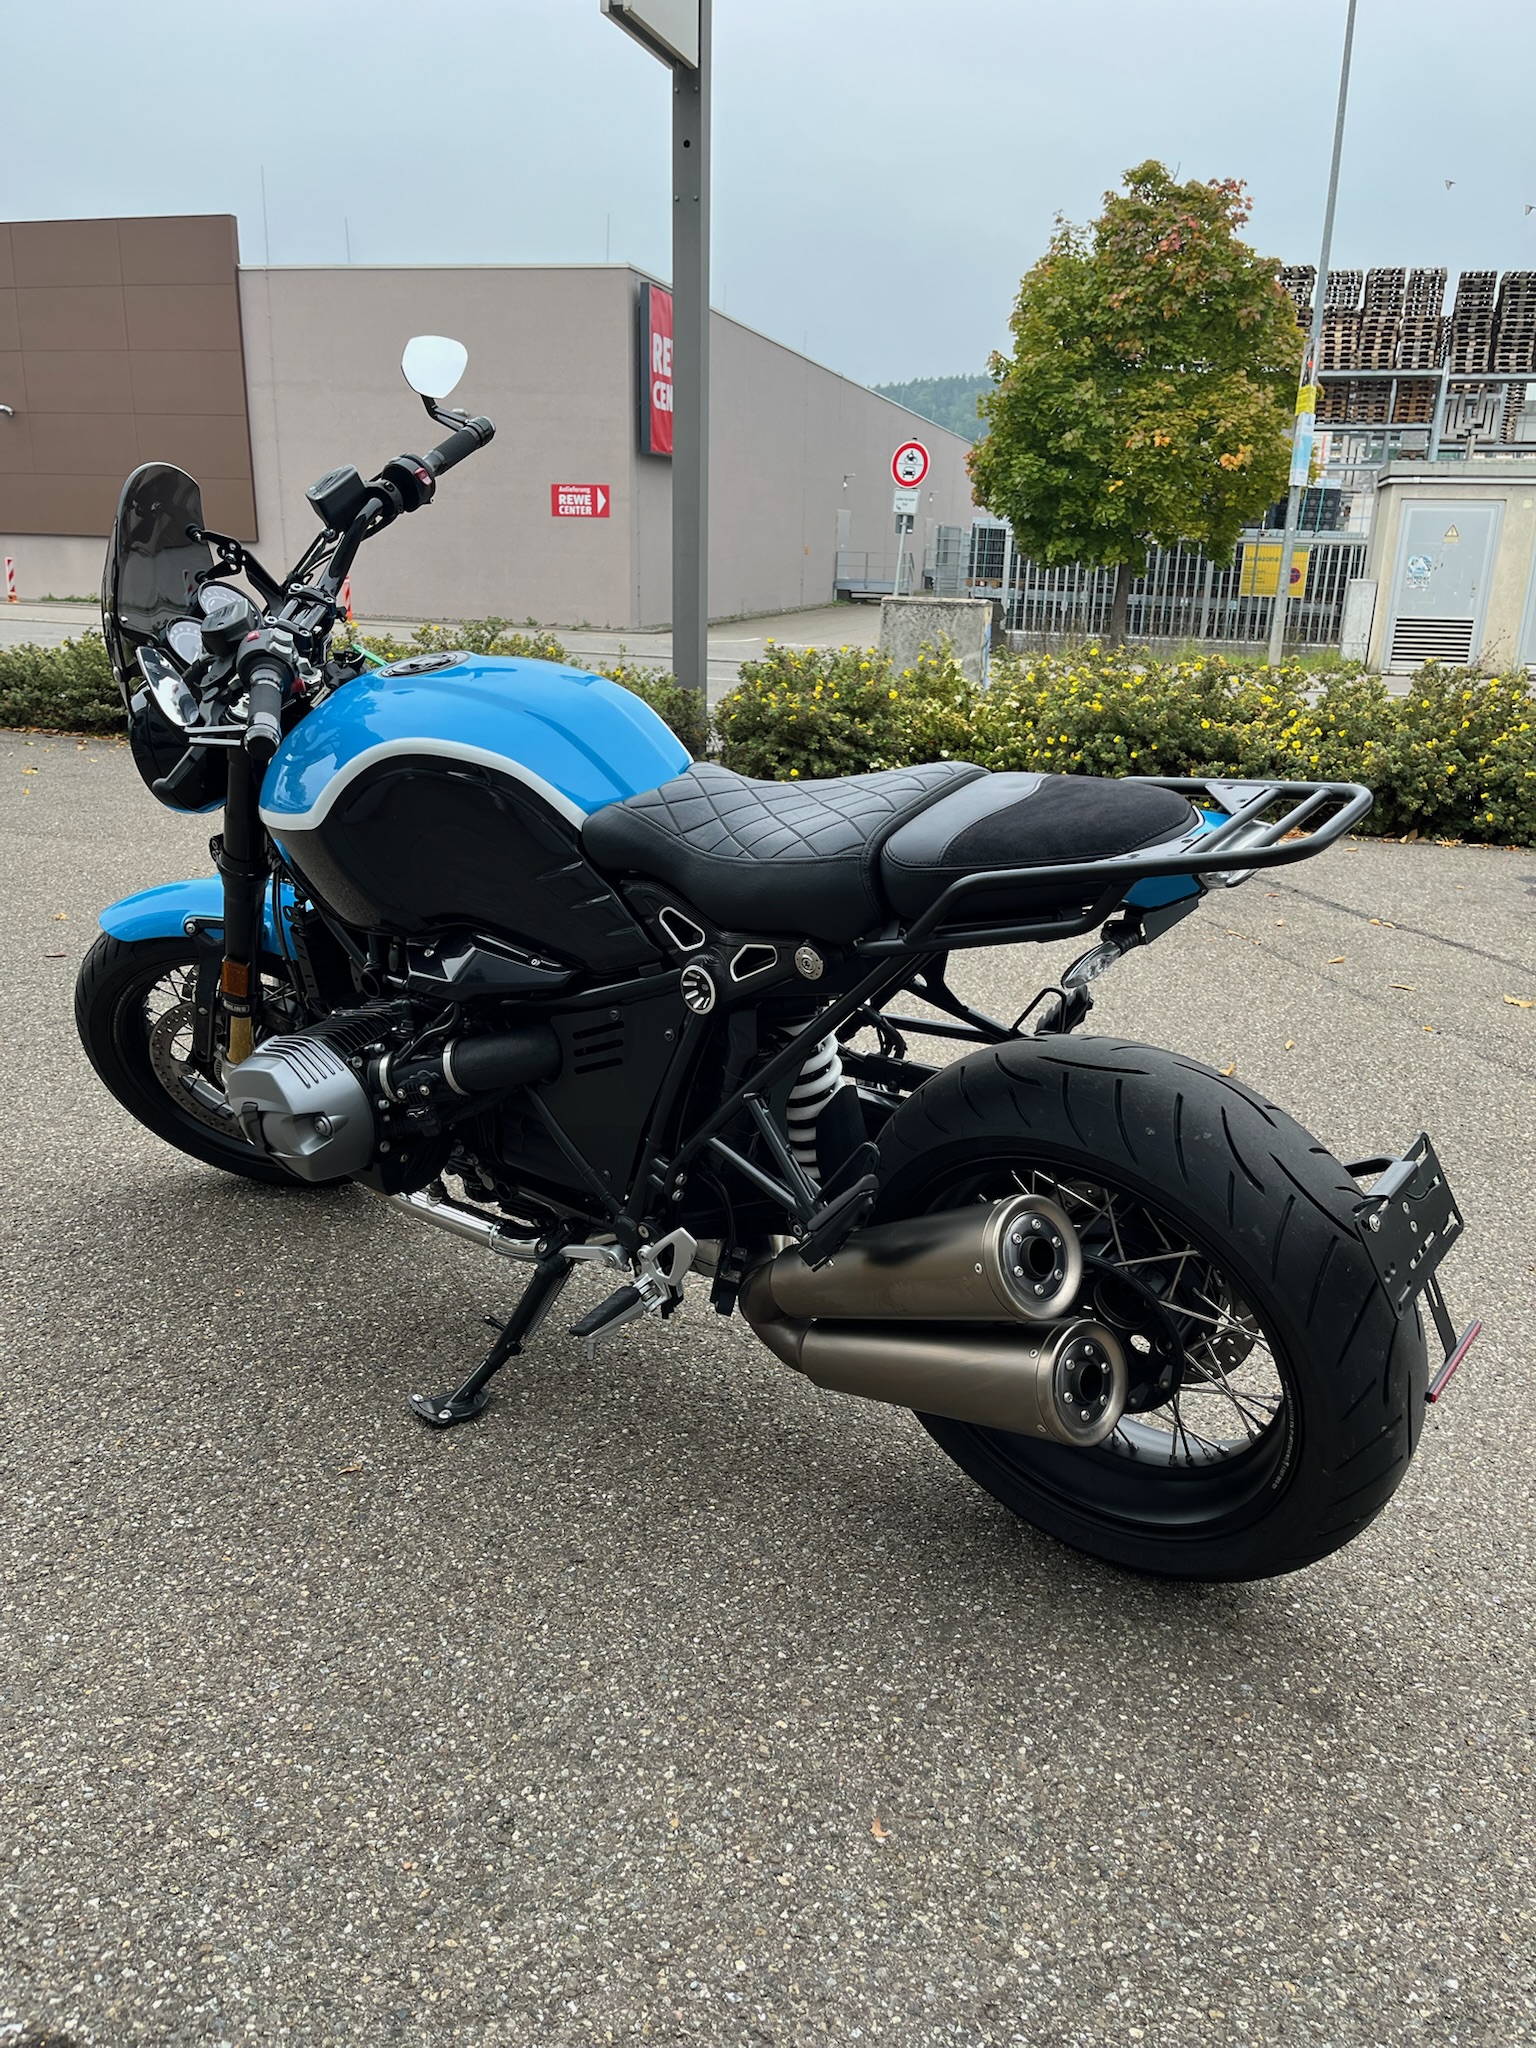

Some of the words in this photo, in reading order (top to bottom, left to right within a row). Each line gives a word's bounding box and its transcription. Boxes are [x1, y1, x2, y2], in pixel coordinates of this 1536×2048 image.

[653, 332, 673, 377] RE
[558, 486, 591, 494] Anlieferung
[558, 494, 592, 505] REWE
[558, 505, 592, 515] CENTER
